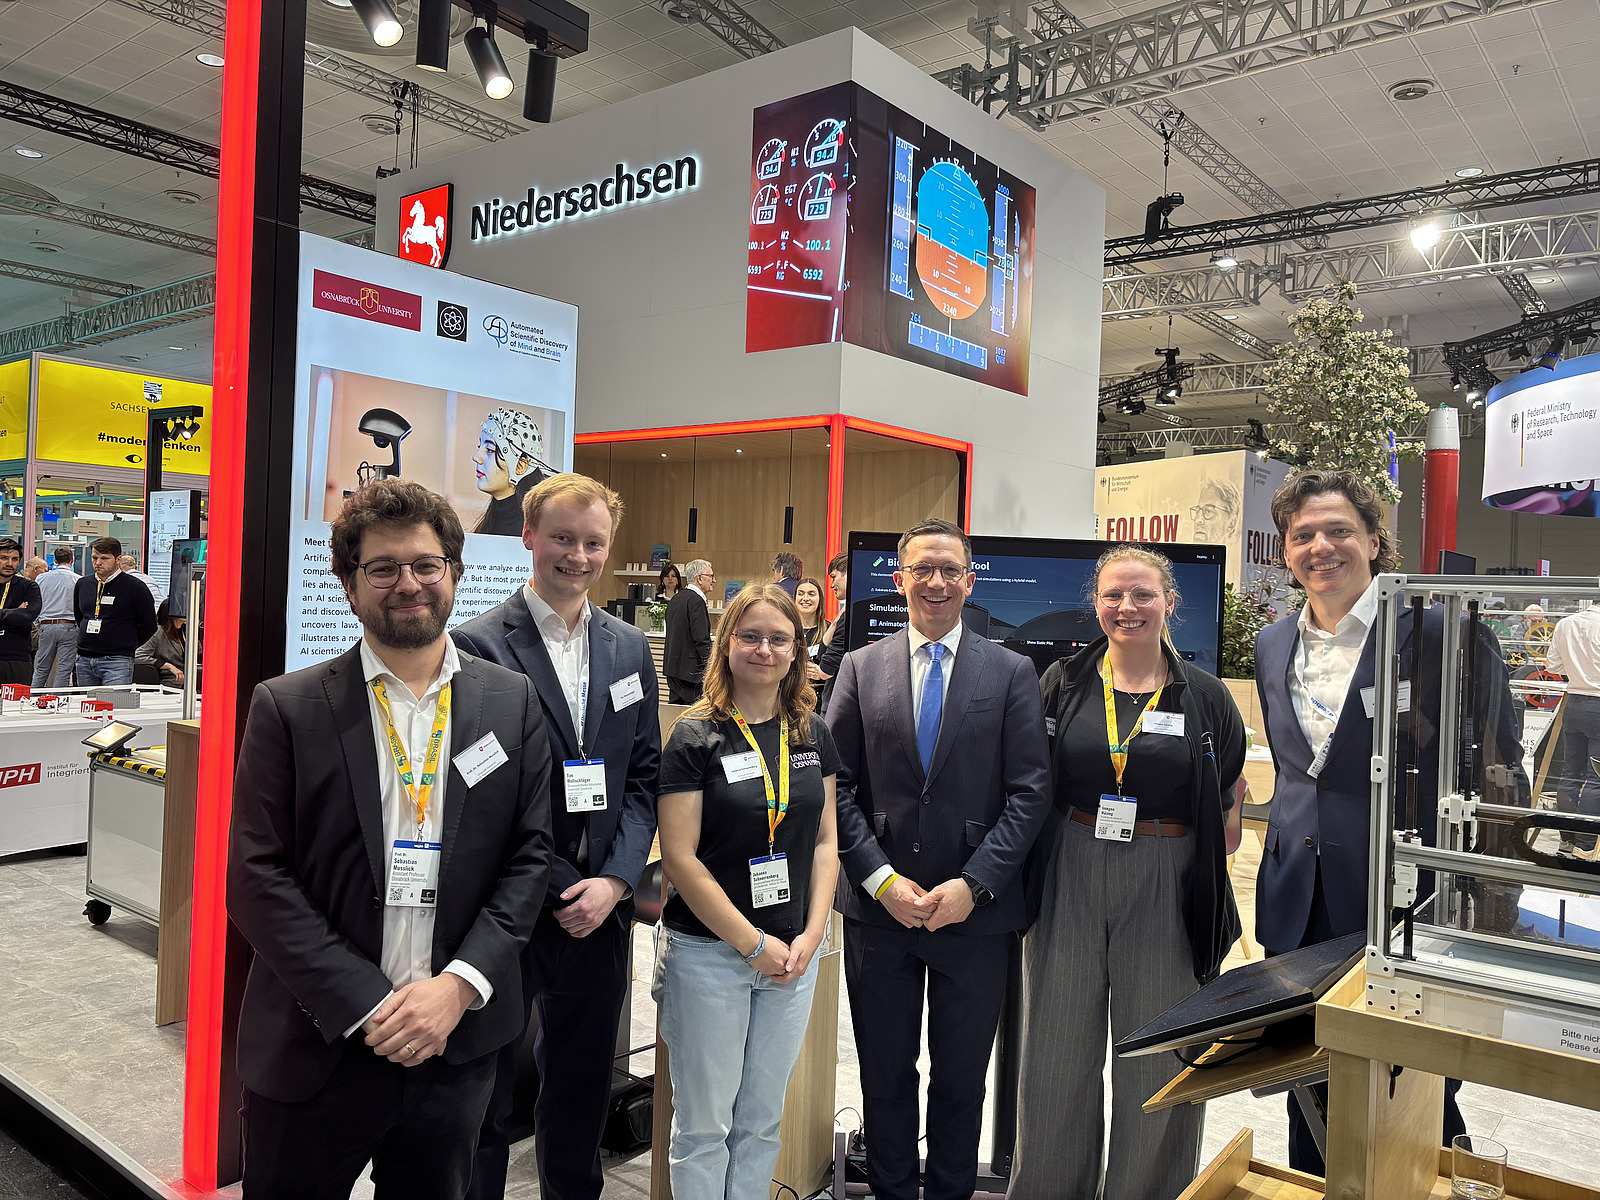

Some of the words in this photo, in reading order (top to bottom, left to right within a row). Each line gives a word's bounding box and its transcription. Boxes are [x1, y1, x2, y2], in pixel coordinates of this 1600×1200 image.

[895, 171, 907, 183] 300
[785, 184, 797, 194] EGT
[997, 183, 1010, 197] 6000
[470, 156, 697, 240] Niedersachsen
[760, 211, 772, 220] 729
[809, 204, 825, 215] 729
[748, 241, 764, 250] 100.1
[806, 239, 831, 251] 100.1
[892, 238, 904, 250] 260
[747, 265, 762, 274] 6593
[803, 269, 824, 280] 6592
[933, 269, 940, 278] 10
[891, 272, 903, 284] 240
[321, 290, 360, 306] OSNABRÜCK
[378, 304, 413, 319] UNIVERSITY
[943, 303, 957, 317] 2340
[510, 321, 544, 335] Automated
[510, 331, 539, 344] Scientific
[539, 338, 568, 352] Discovery
[517, 342, 533, 352] Mind
[533, 345, 545, 354] and
[545, 348, 561, 358] Brain
[1527, 407, 1546, 418] Federal
[1547, 401, 1572, 414] Ministry
[1526, 421, 1533, 429] of
[1533, 415, 1559, 428] Research,
[1560, 408, 1598, 422] Technology
[1526, 431, 1536, 440] and
[1537, 428, 1553, 440] Space
[1106, 514, 1179, 542] FOLLOW
[304, 537, 326, 547] Meet
[1246, 529, 1280, 566] FOLLO
[303, 553, 332, 563] Artifici
[488, 564, 513, 573] analyze
[515, 565, 529, 573] data
[971, 561, 990, 570] Tool
[303, 567, 333, 577] comple
[471, 574, 482, 582] But
[493, 576, 508, 584] most
[510, 577, 528, 585] profo
[302, 580, 316, 588] lies
[456, 586, 481, 594] cientific
[302, 608, 317, 616] and
[320, 607, 353, 616] discover
[301, 621, 337, 629] uncovers
[341, 621, 359, 629] laws
[301, 633, 339, 642] illustrates
[300, 647, 309, 655] AI
[1, 685, 15, 700] IPH
[431, 739, 441, 763] BRASIL
[1561, 1028, 1581, 1039] Bitte
[1559, 1039, 1590, 1052] Please
